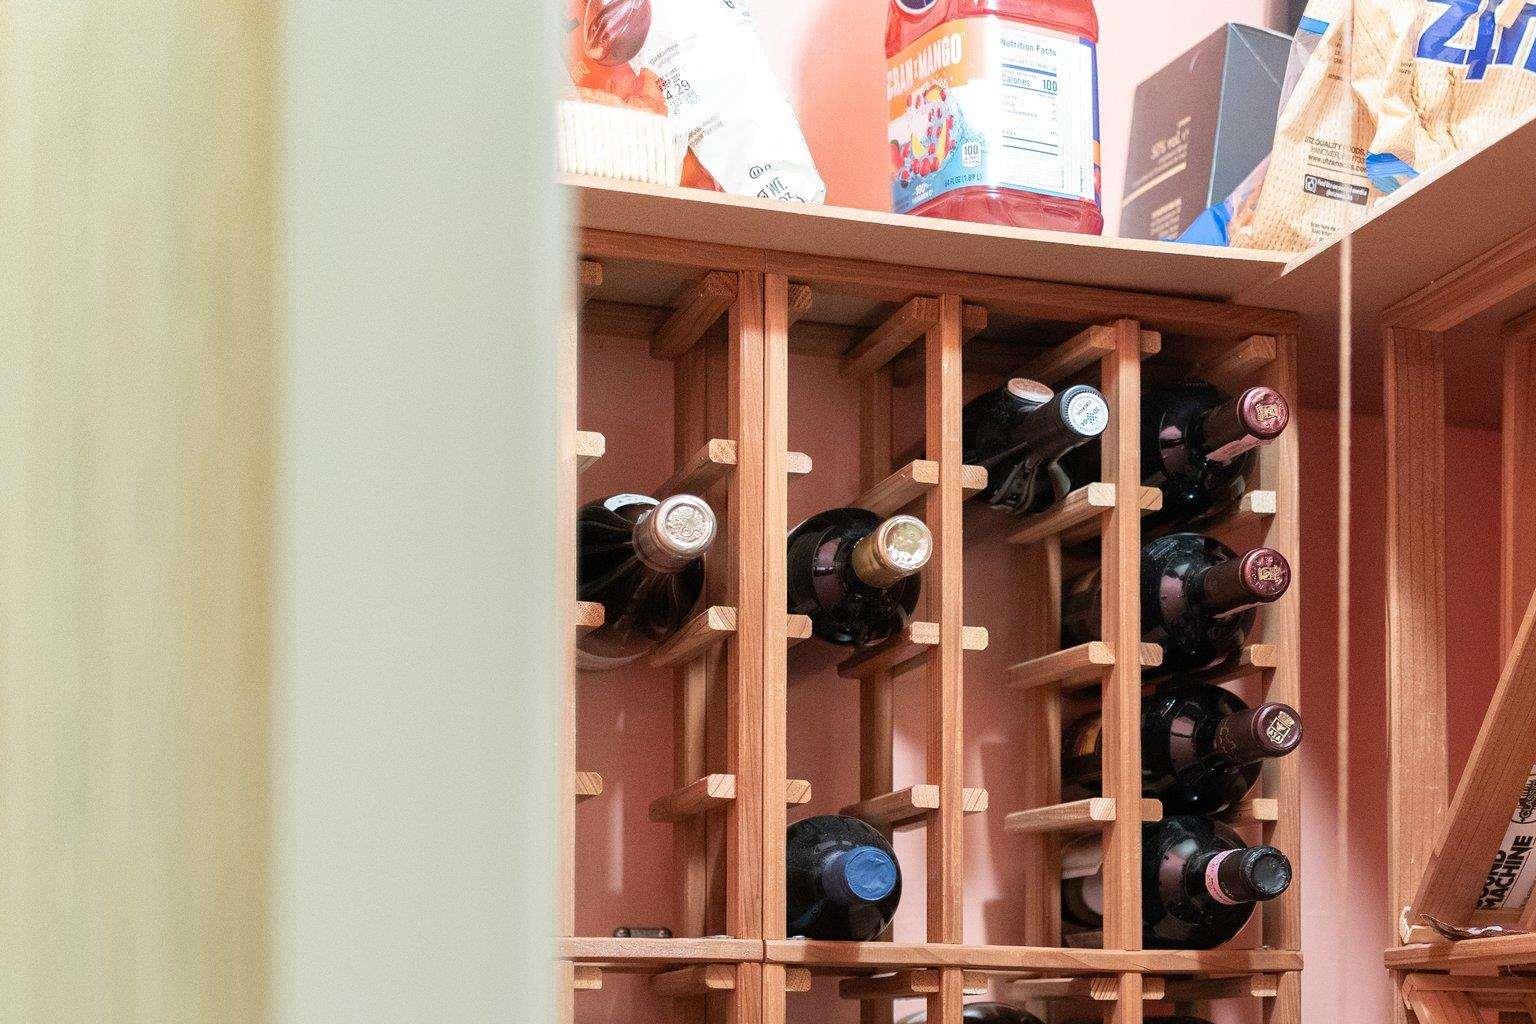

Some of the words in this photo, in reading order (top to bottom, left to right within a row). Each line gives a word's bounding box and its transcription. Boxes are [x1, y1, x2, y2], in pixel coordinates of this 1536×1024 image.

[1001, 38, 1034, 52] Nutrition
[1036, 45, 1057, 56] Facts
[1042, 80, 1058, 91] 100
[964, 145, 979, 155] 100
[1314, 138, 1342, 150] QUALITY
[1481, 835, 1533, 910] MACHINE
